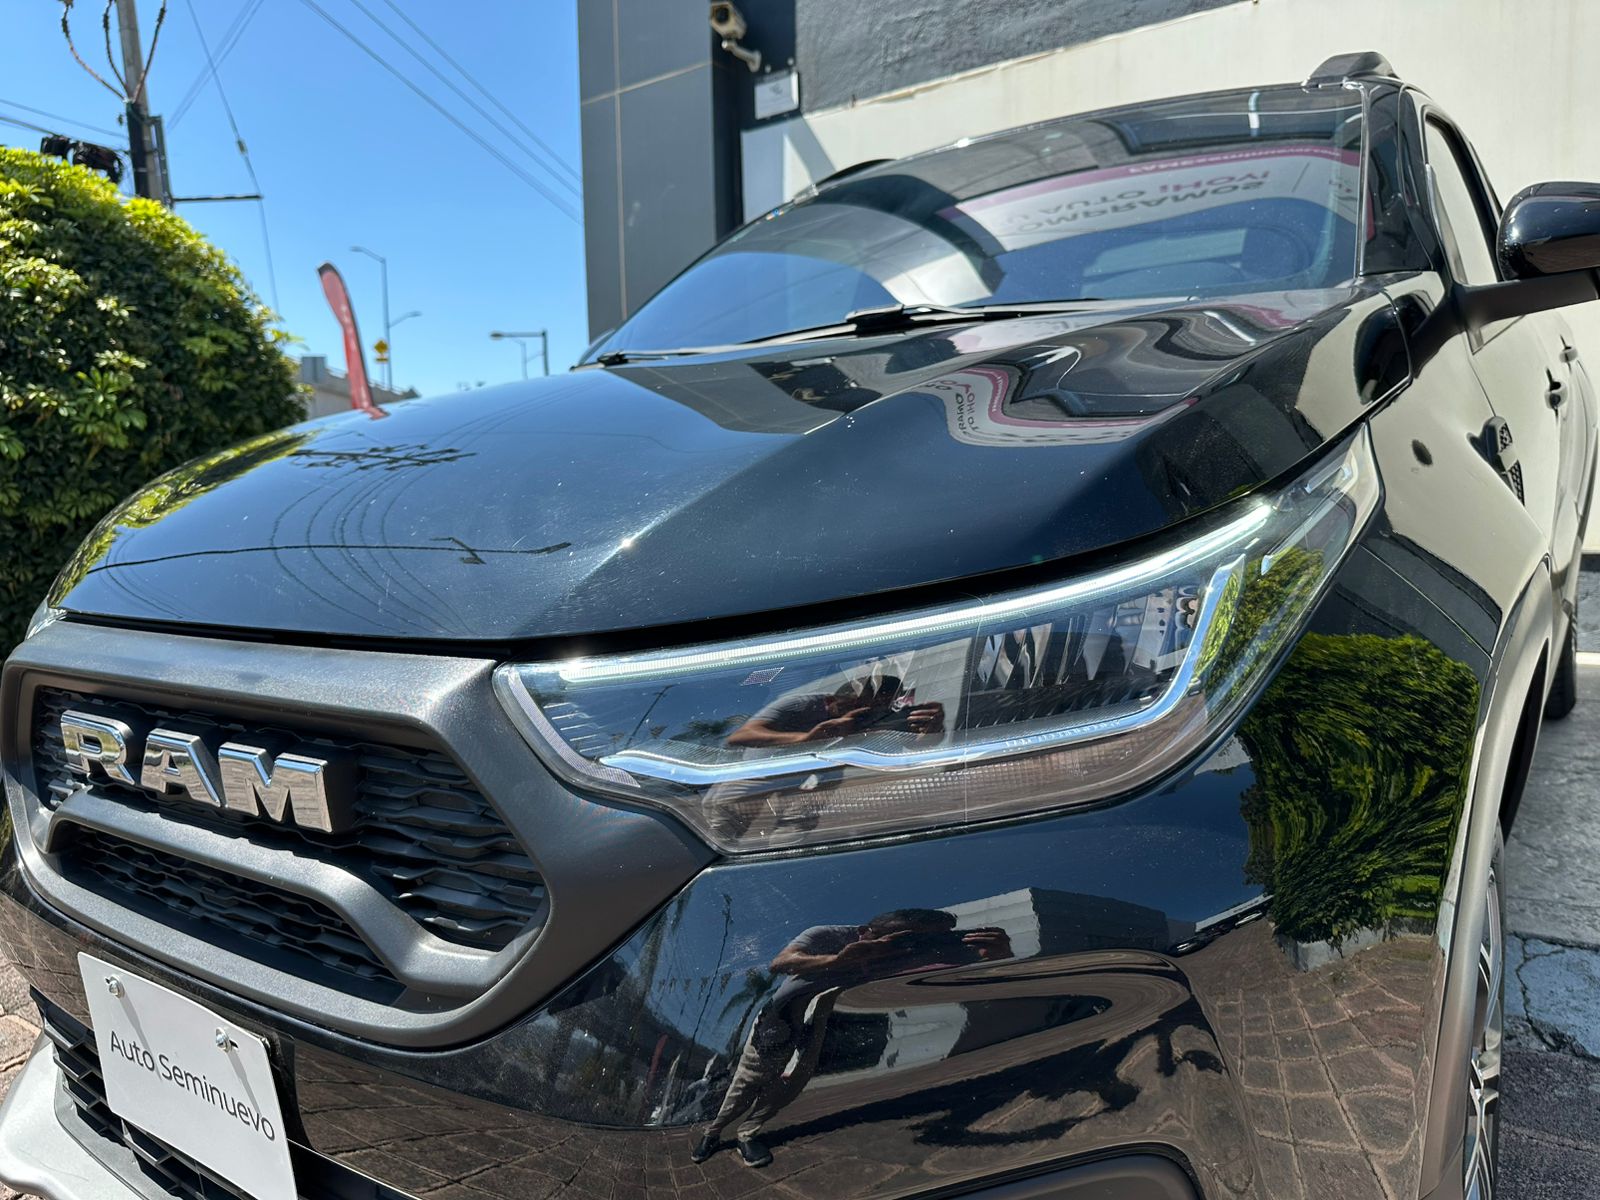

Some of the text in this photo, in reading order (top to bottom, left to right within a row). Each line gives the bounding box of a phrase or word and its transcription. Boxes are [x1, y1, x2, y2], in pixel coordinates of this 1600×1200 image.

[60, 709, 333, 834] RAM
[110, 1030, 276, 1142] Auto Seminuevo
